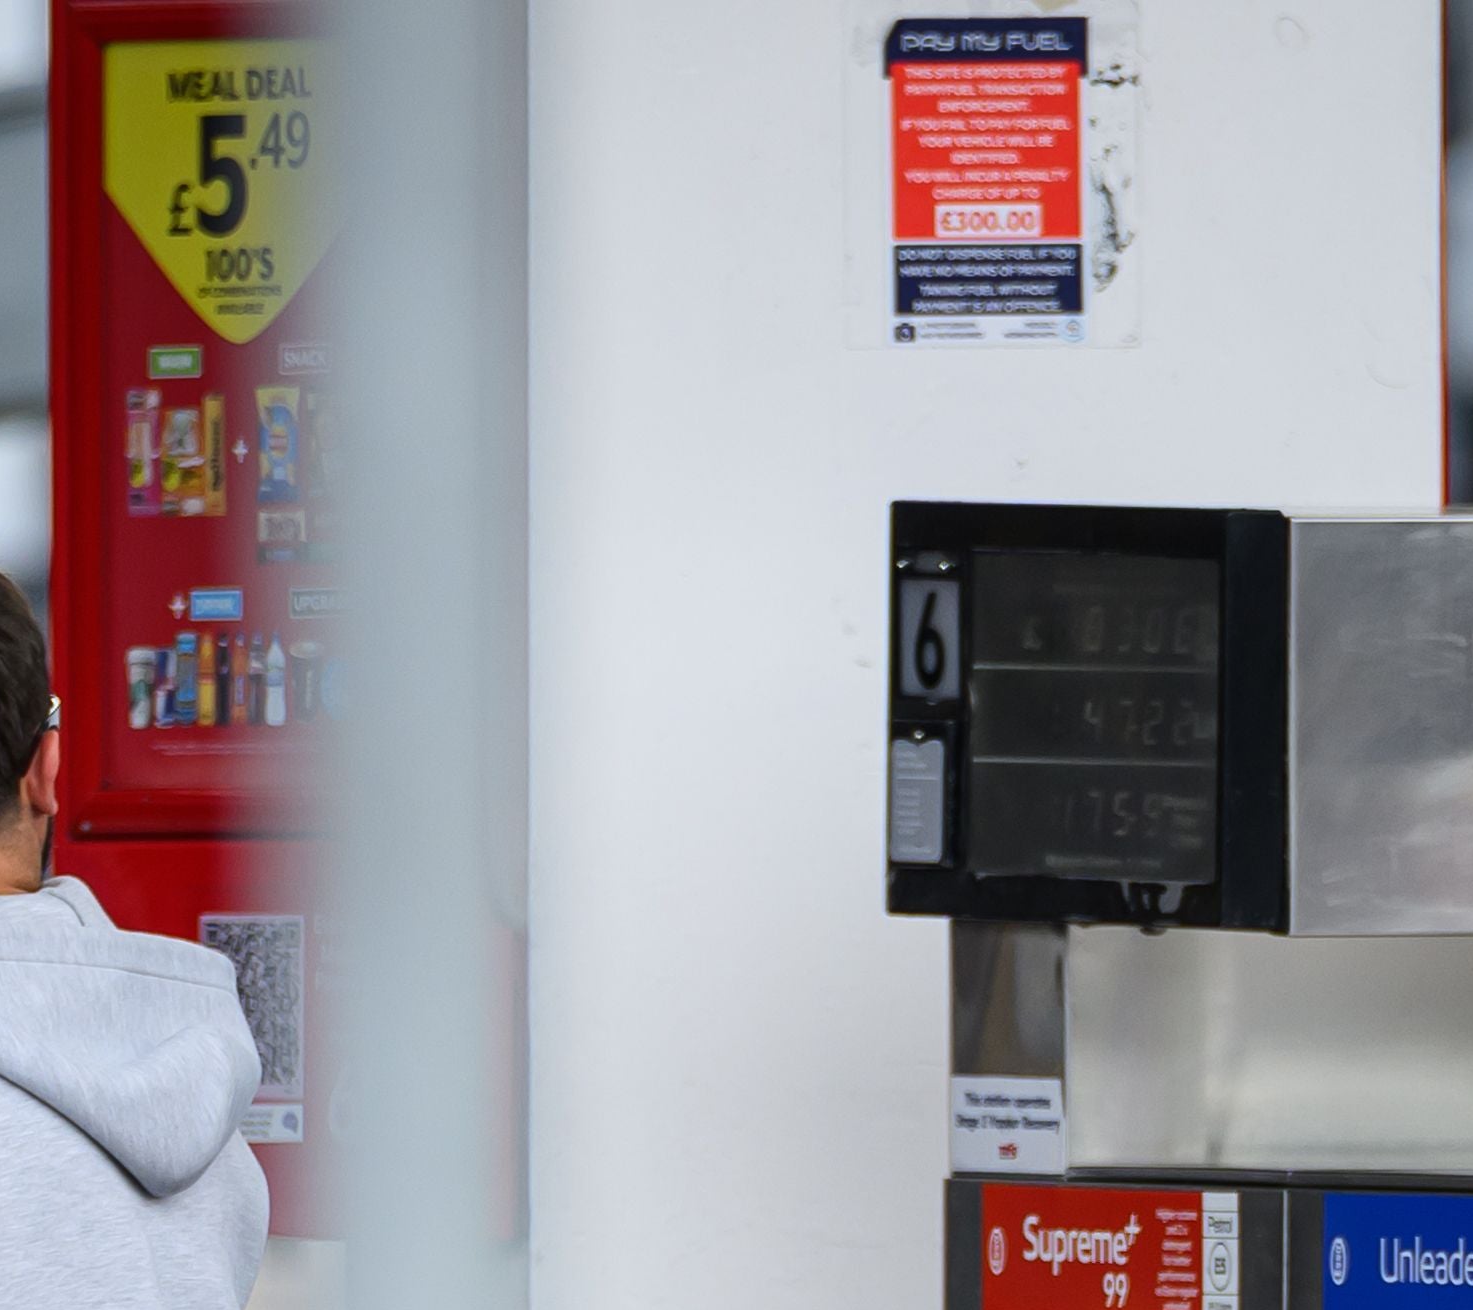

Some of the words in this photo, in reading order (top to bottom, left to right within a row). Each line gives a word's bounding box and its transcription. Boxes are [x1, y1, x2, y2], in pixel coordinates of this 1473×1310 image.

[901, 32, 955, 52] PAY
[961, 32, 1001, 52] MY
[1006, 32, 1073, 52] FUEL
[166, 70, 239, 103] MEAL
[244, 66, 312, 100] DEAL
[941, 211, 1036, 232] £300.00
[205, 248, 274, 282] 100'S
[915, 591, 945, 690] 6
[1102, 1272, 1130, 1308] 99
